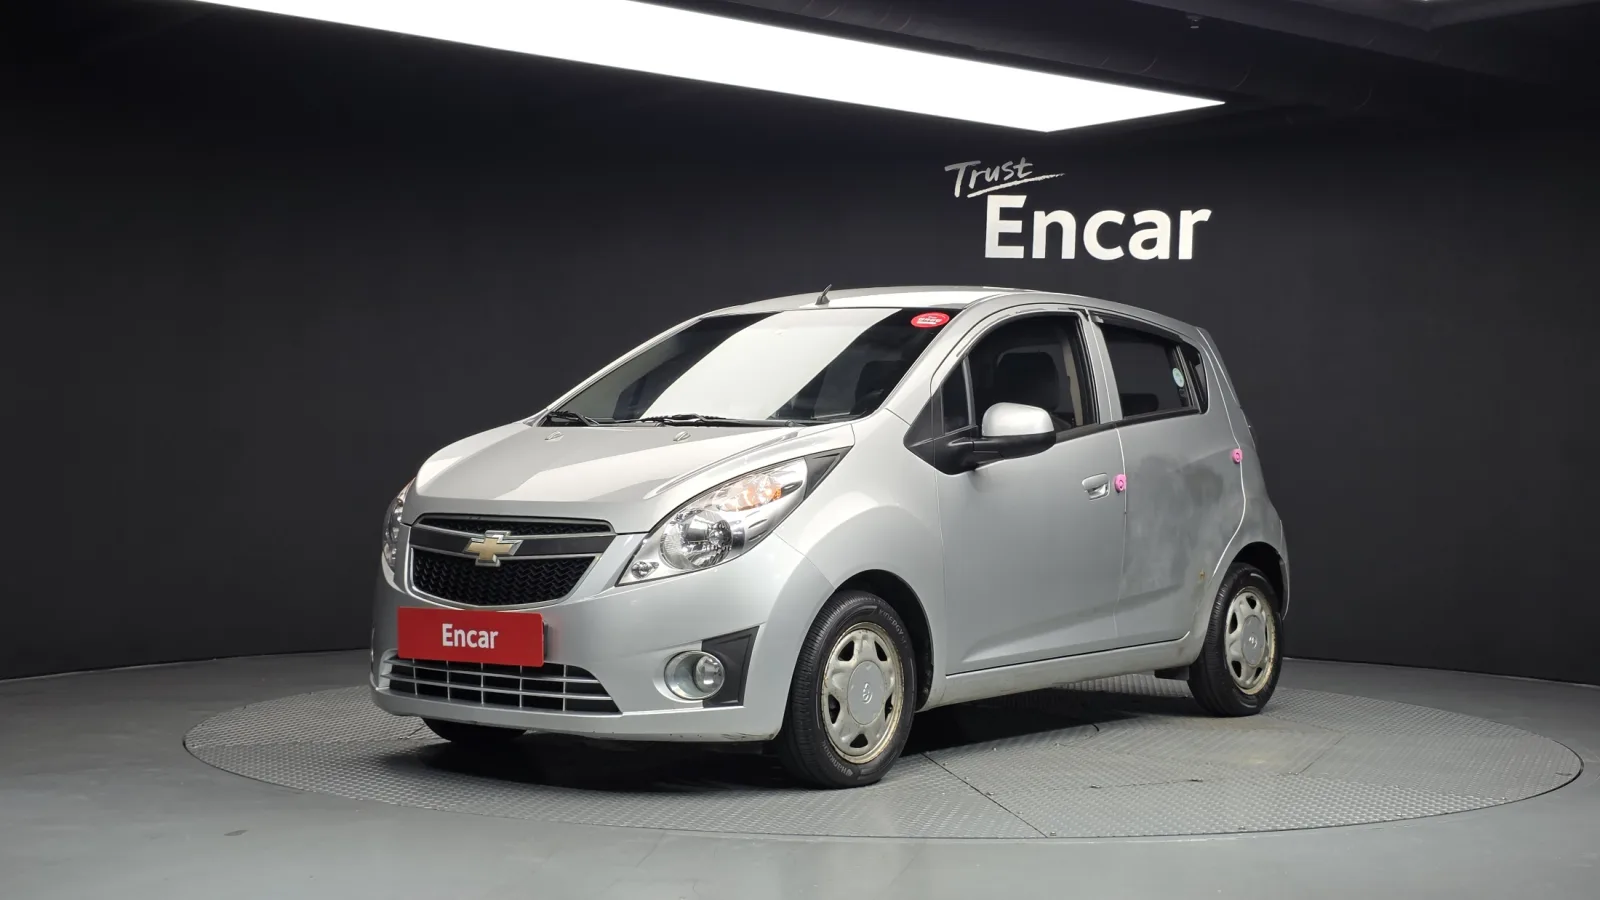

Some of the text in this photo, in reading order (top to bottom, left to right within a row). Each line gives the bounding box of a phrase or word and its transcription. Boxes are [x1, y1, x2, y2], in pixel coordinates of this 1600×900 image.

[944, 156, 1034, 198] Trust
[985, 194, 1212, 261] Encar
[442, 623, 499, 649] Encar
